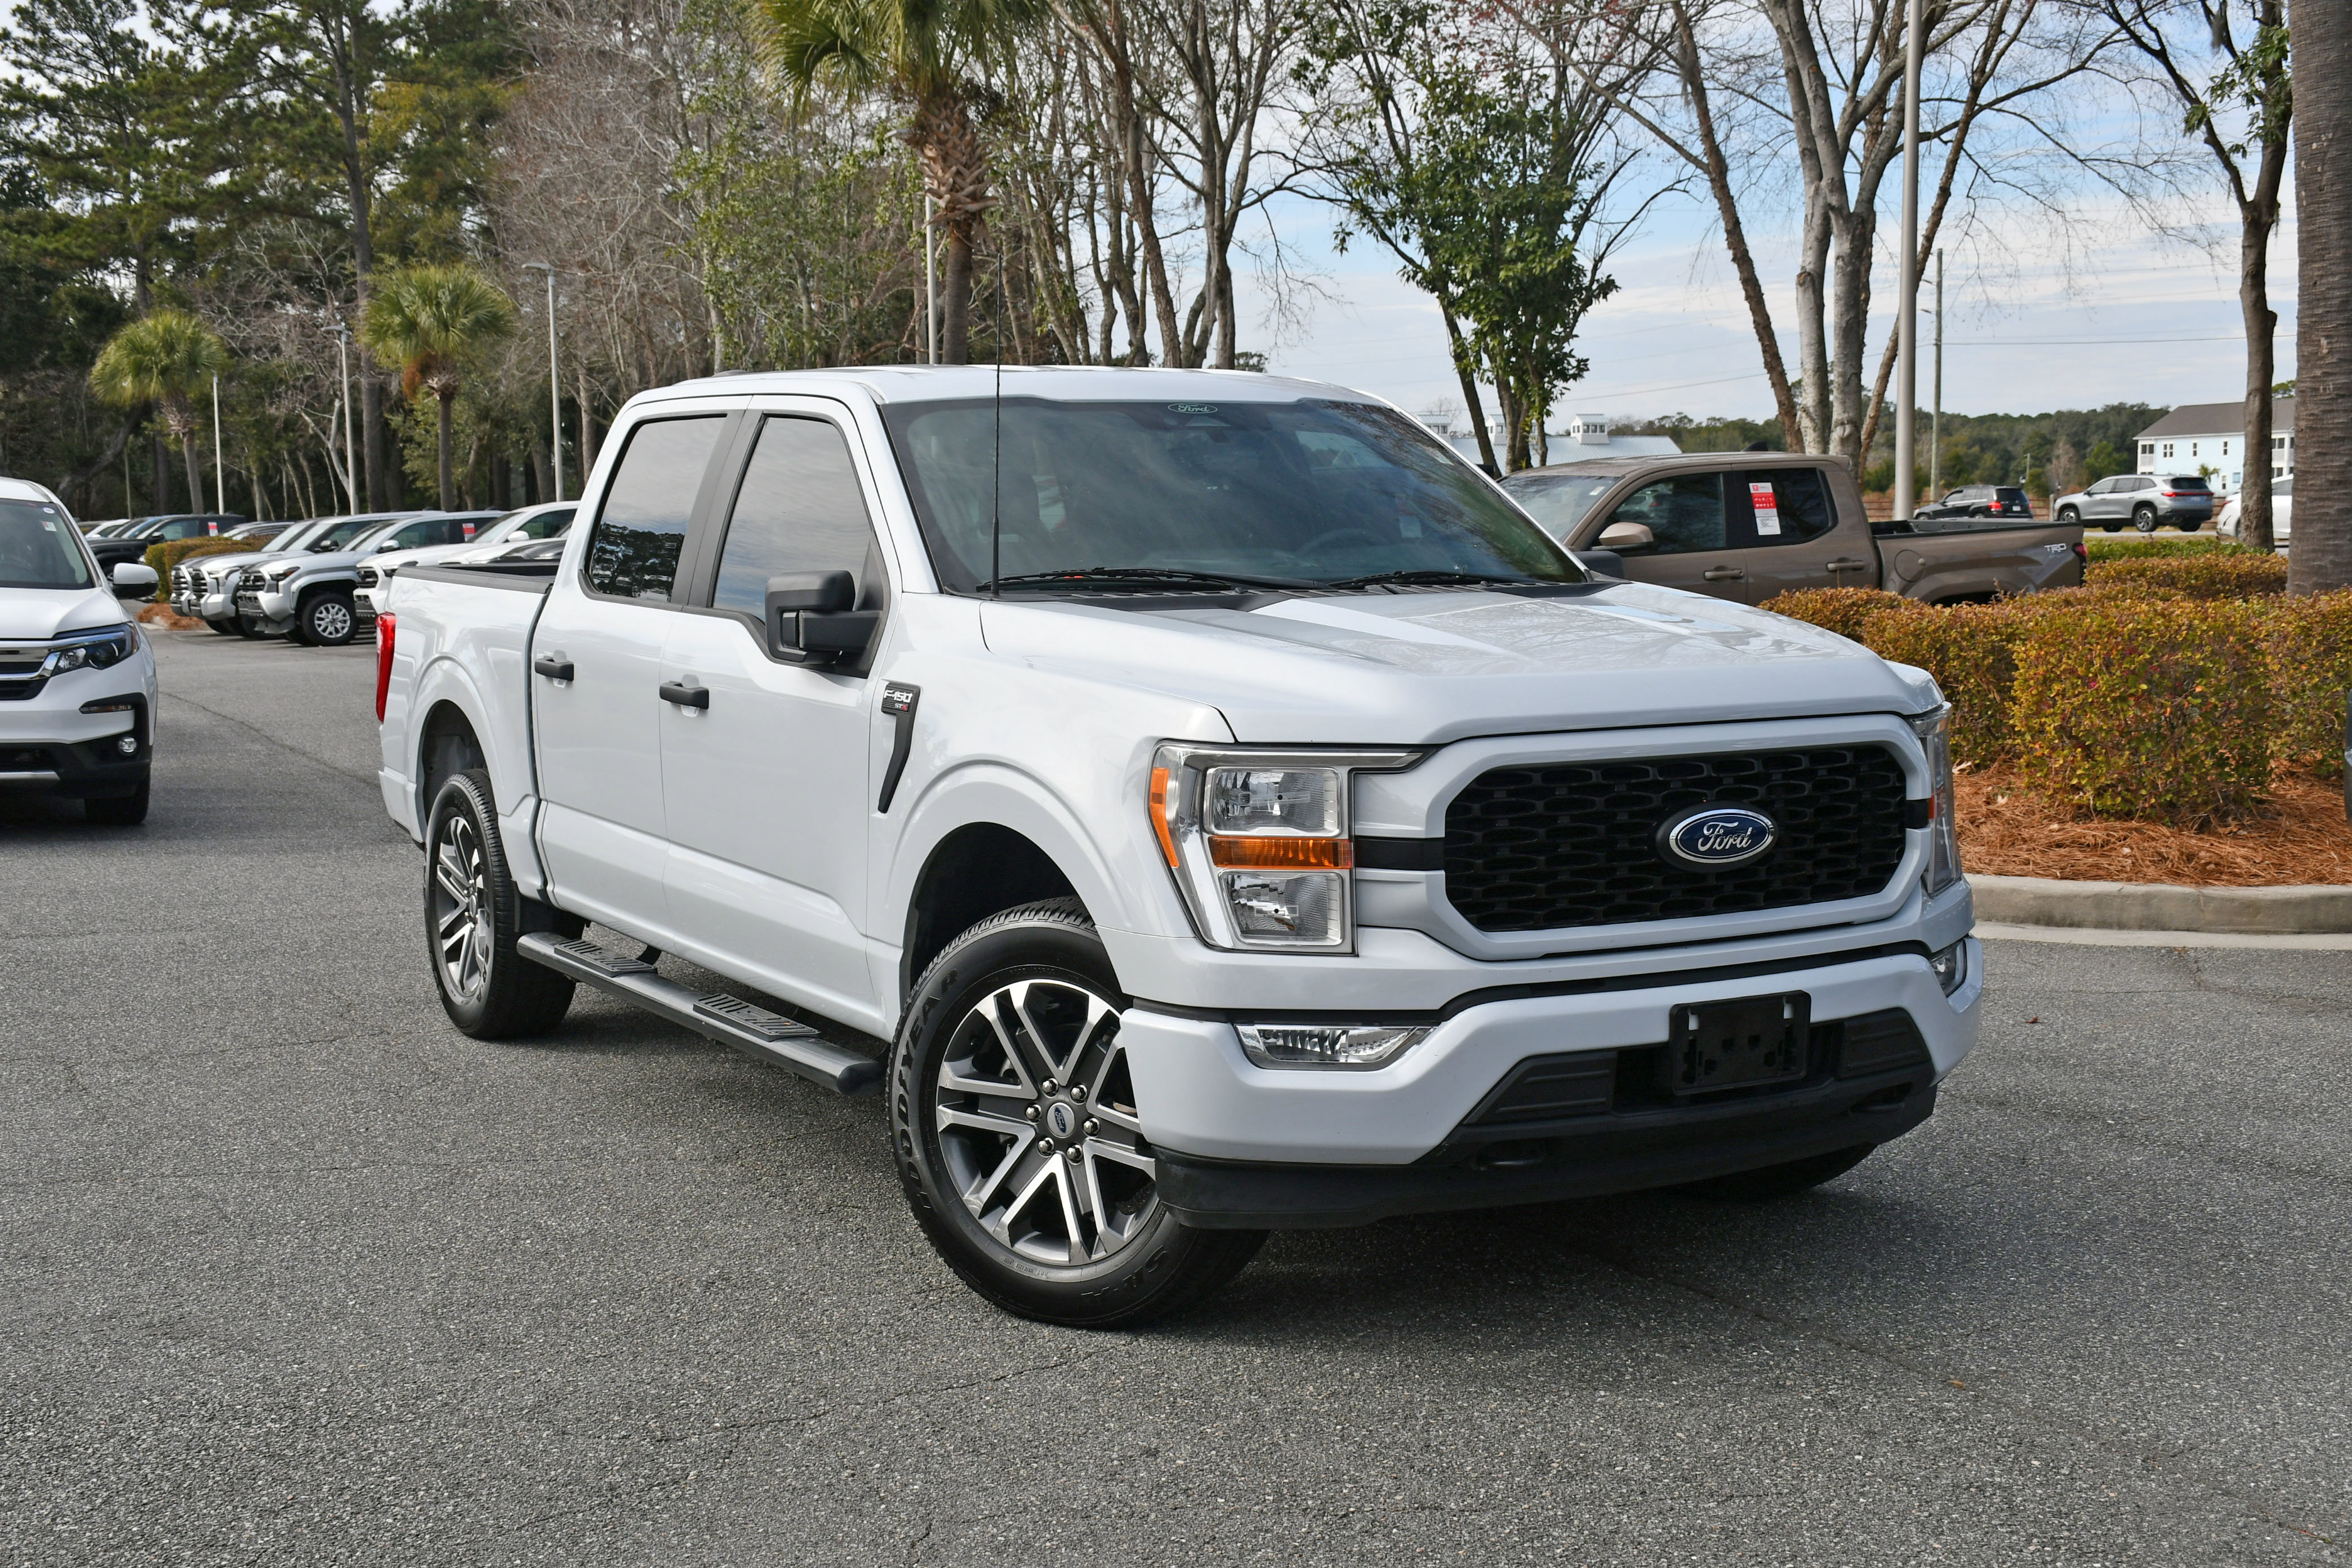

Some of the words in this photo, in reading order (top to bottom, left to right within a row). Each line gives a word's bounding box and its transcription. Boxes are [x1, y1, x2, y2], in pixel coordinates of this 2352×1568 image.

[2043, 543, 2066, 553] TRD
[884, 689, 912, 703] F-150
[1698, 822, 1752, 852] Ford
[1055, 1111, 1064, 1129] Ford
